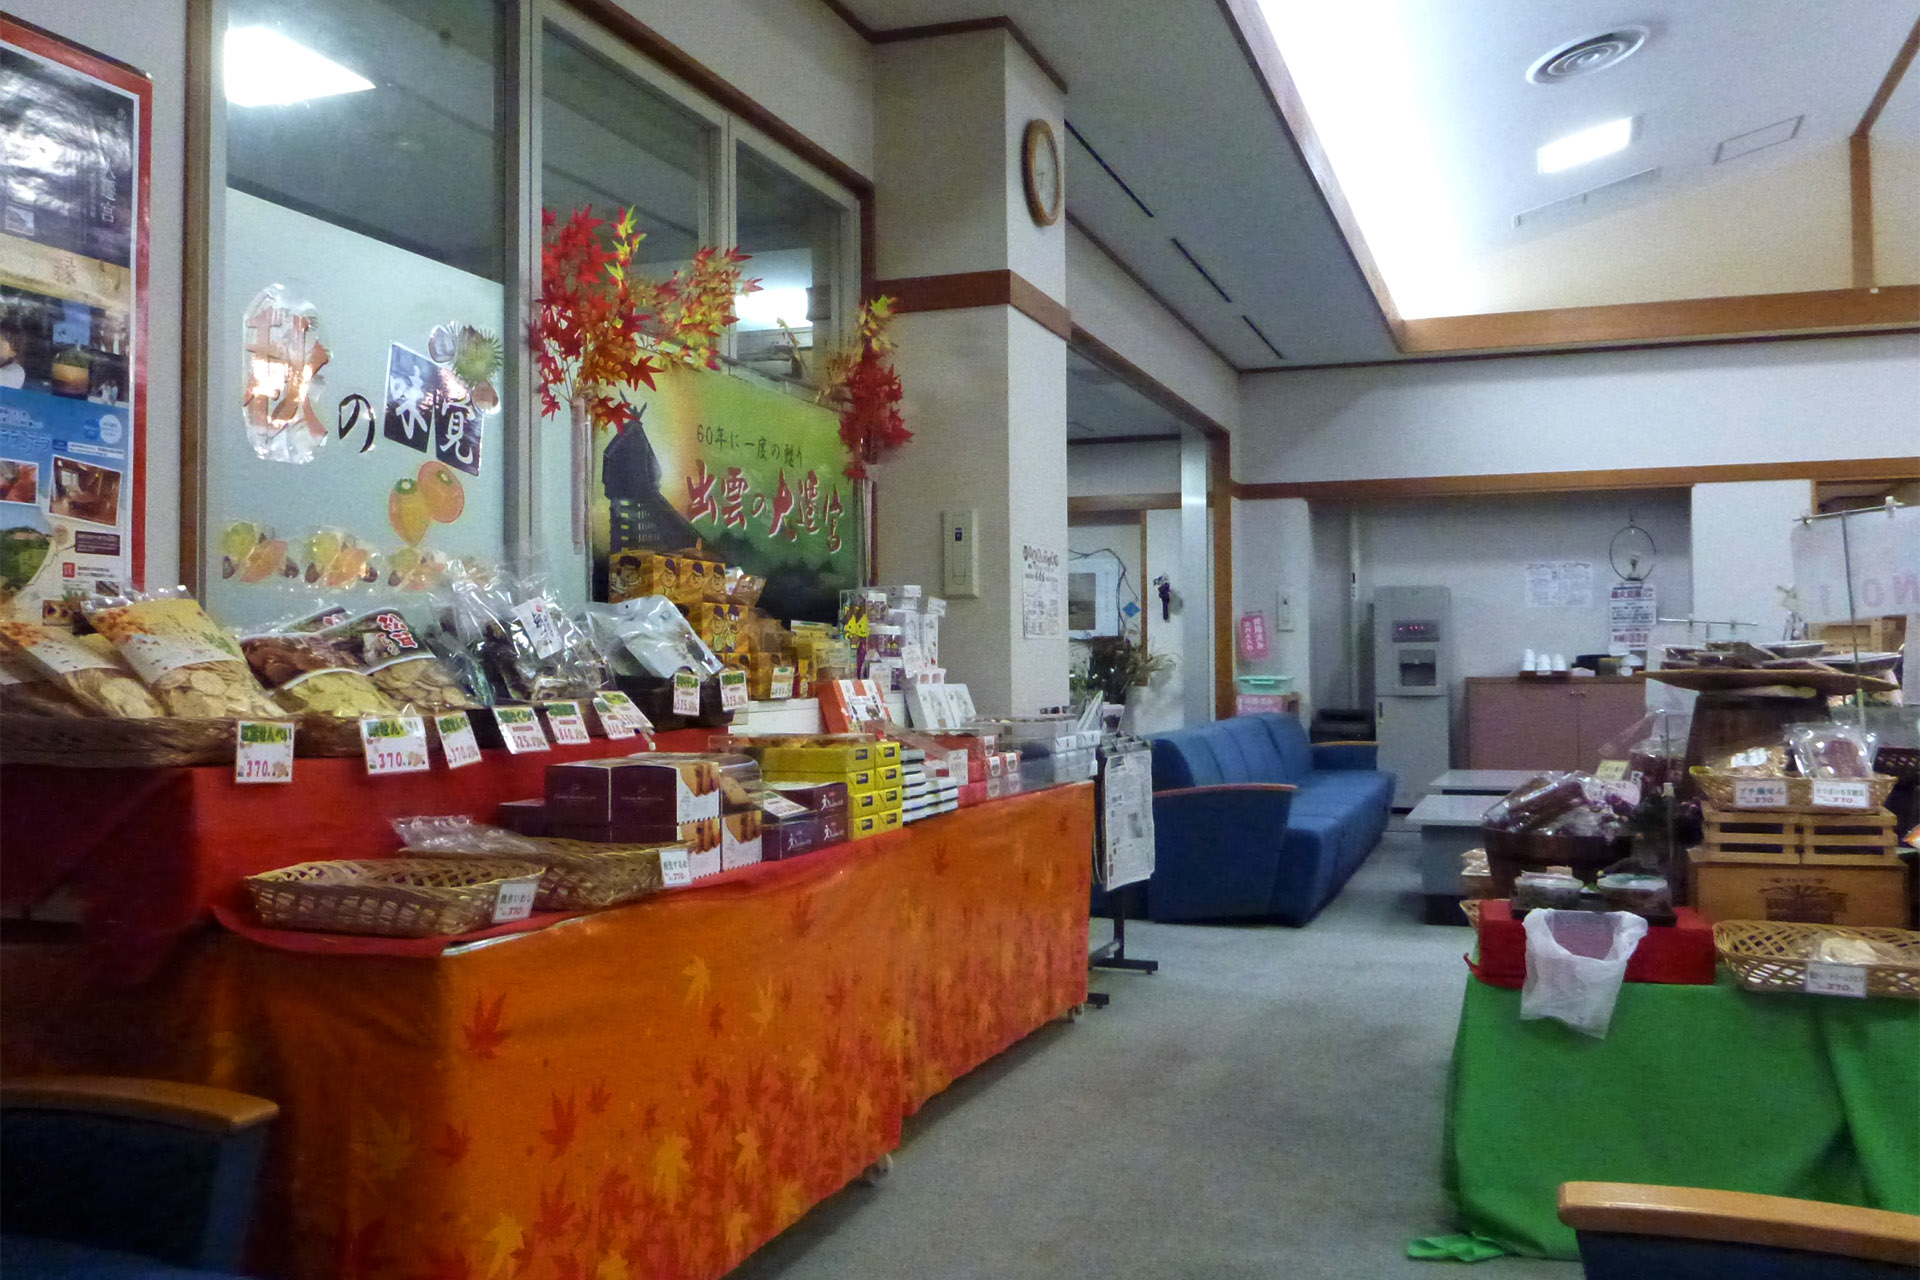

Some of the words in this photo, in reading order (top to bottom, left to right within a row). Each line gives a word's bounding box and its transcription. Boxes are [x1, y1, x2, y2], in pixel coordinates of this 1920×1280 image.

[243, 296, 476, 465] 秋の味覚
[686, 459, 846, 555] 出雲の大遷宮
